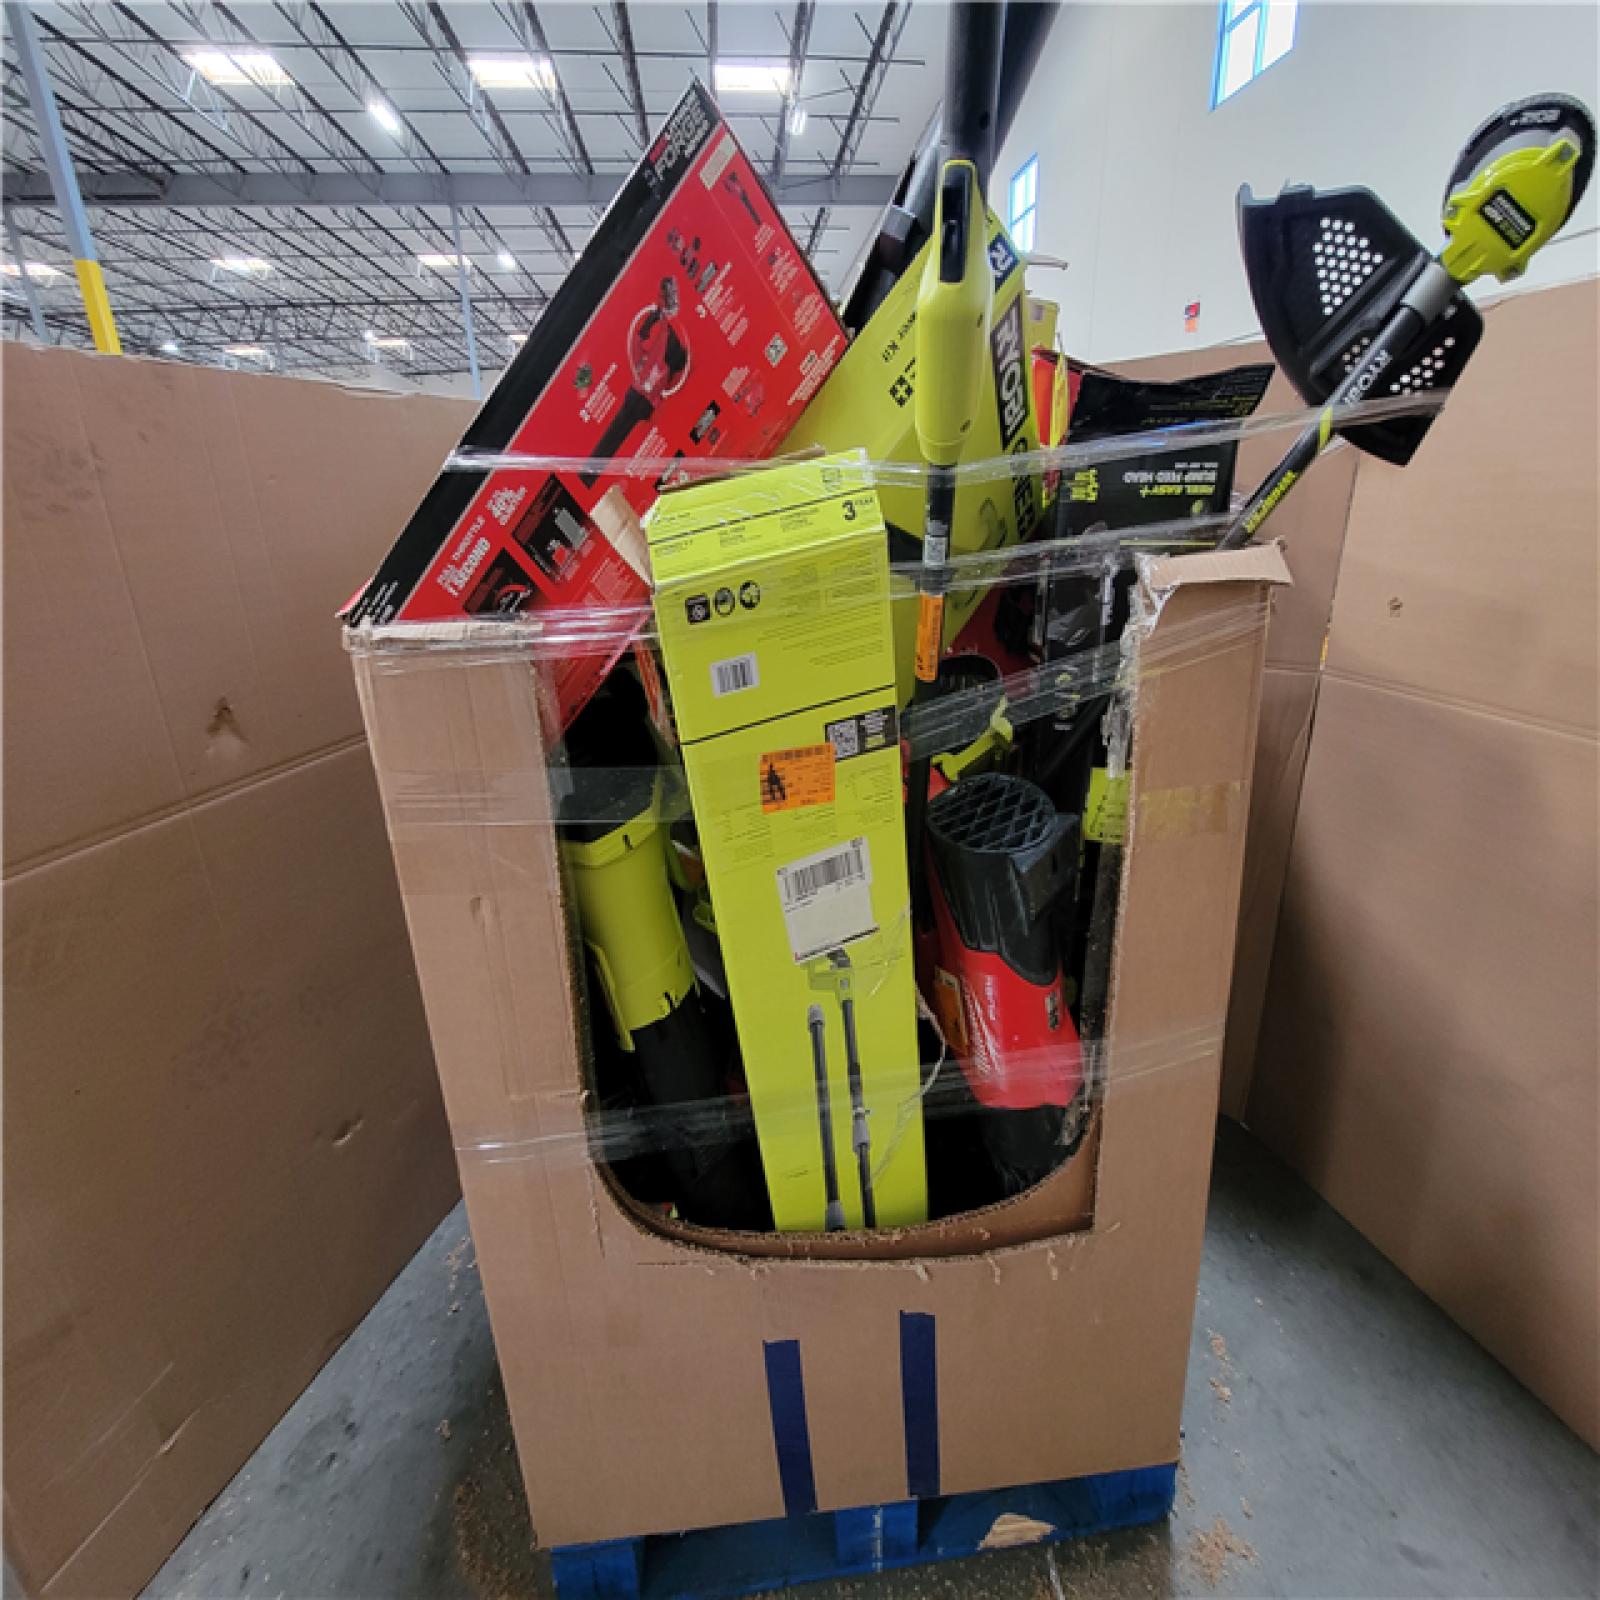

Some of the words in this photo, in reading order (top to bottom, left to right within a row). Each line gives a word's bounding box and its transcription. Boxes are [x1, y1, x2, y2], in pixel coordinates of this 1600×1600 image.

[996, 303, 1026, 438] RYOBI
[1342, 349, 1393, 409] RYOBI
[842, 500, 856, 521] 3
